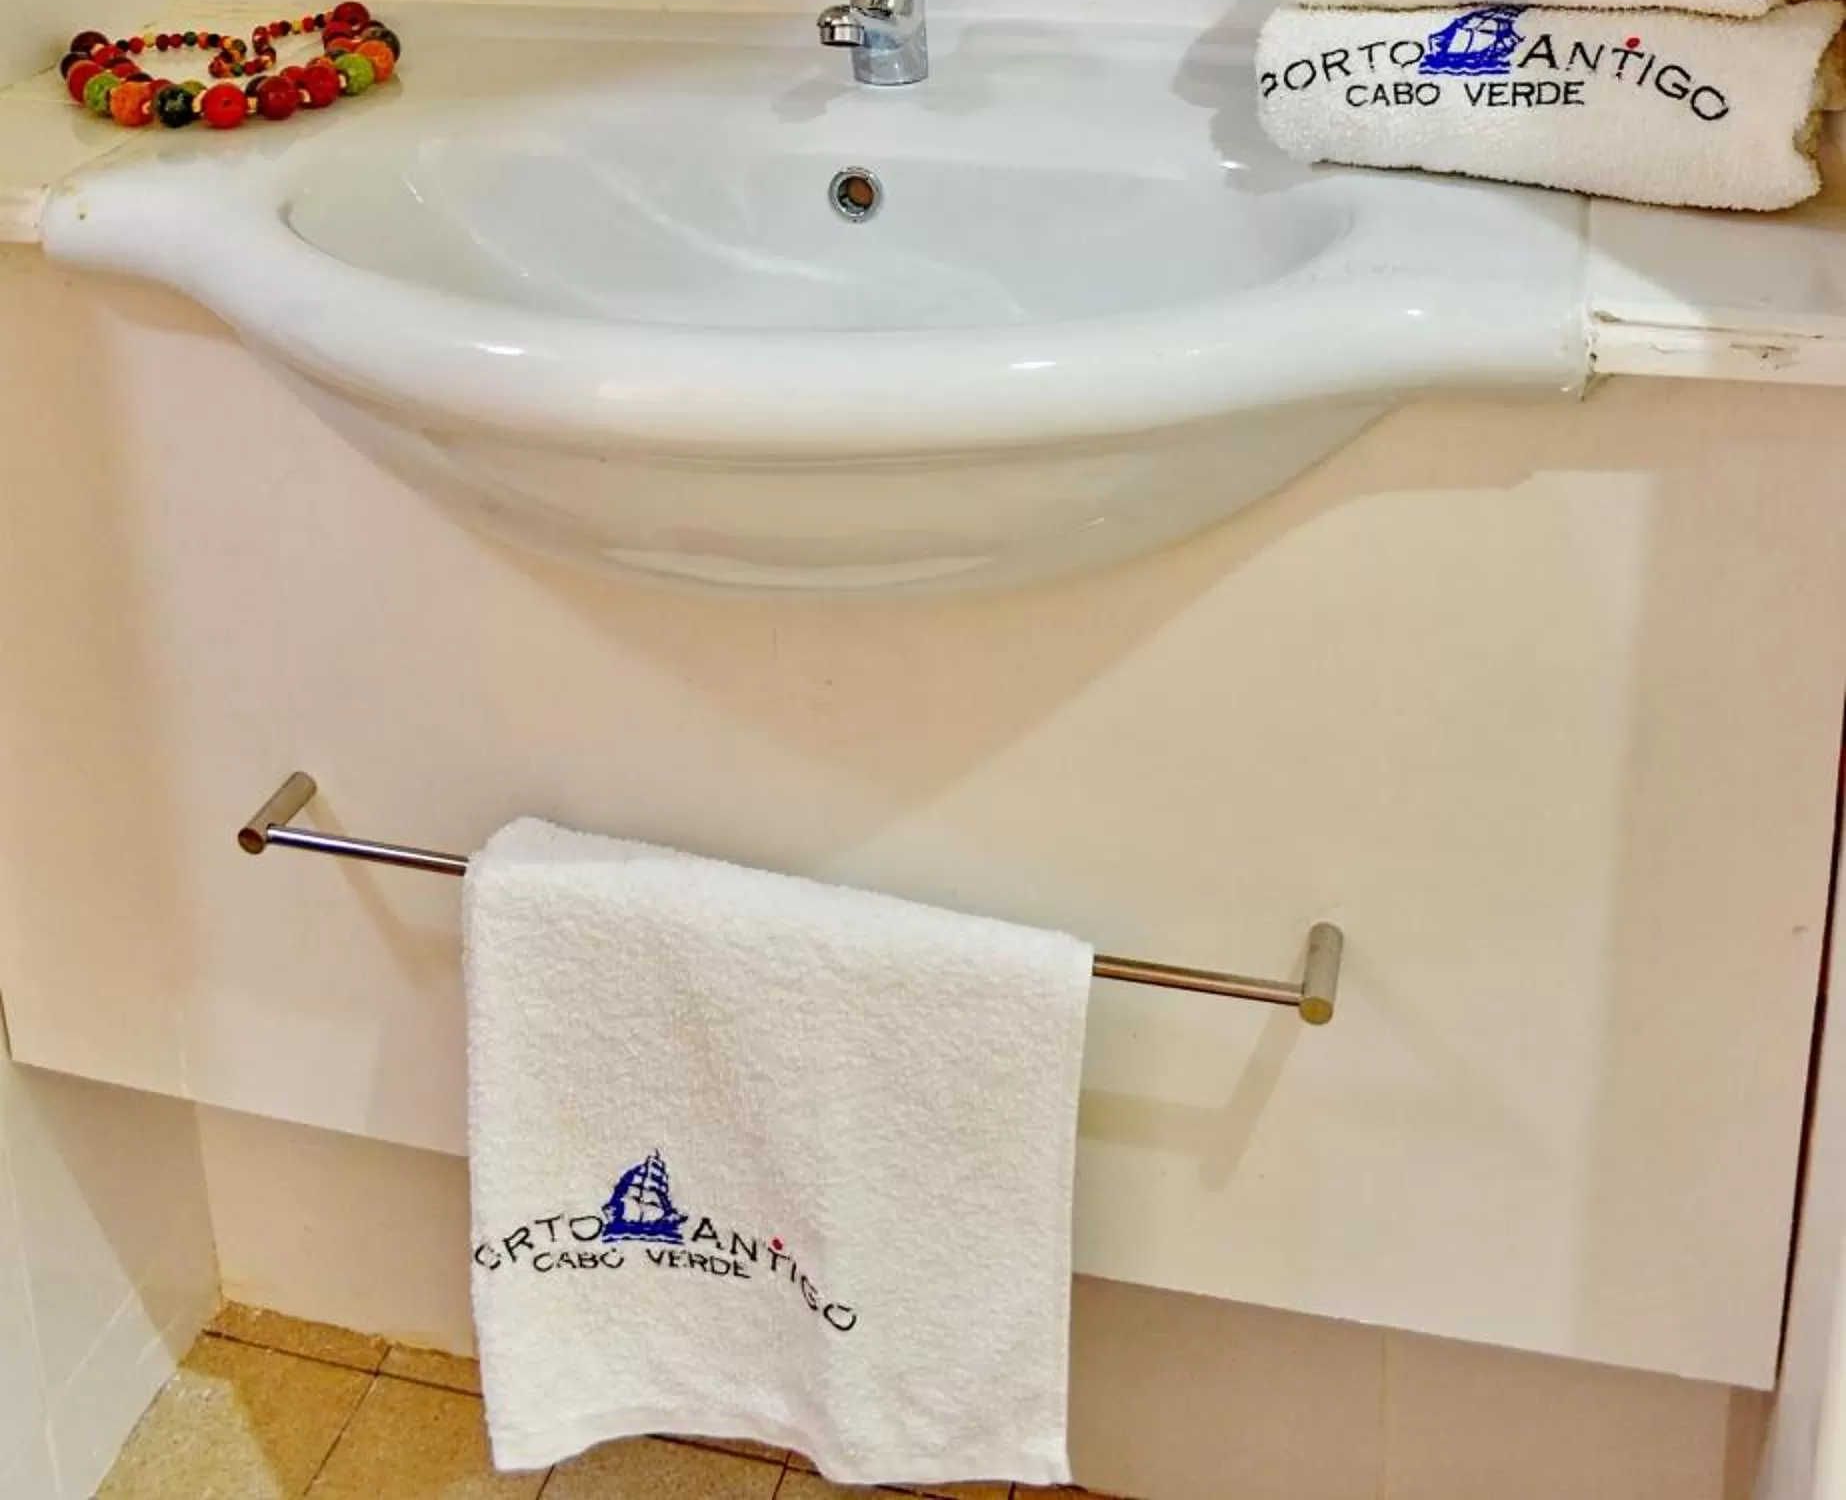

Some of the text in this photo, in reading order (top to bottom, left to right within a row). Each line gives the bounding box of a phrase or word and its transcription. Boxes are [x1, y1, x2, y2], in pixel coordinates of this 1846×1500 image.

[1345, 81, 1585, 107] CABO VERDE
[1517, 35, 1729, 121] ANTIGO
[532, 1249, 752, 1279] CABO VERDE
[691, 1217, 857, 1332] ANTIGO
